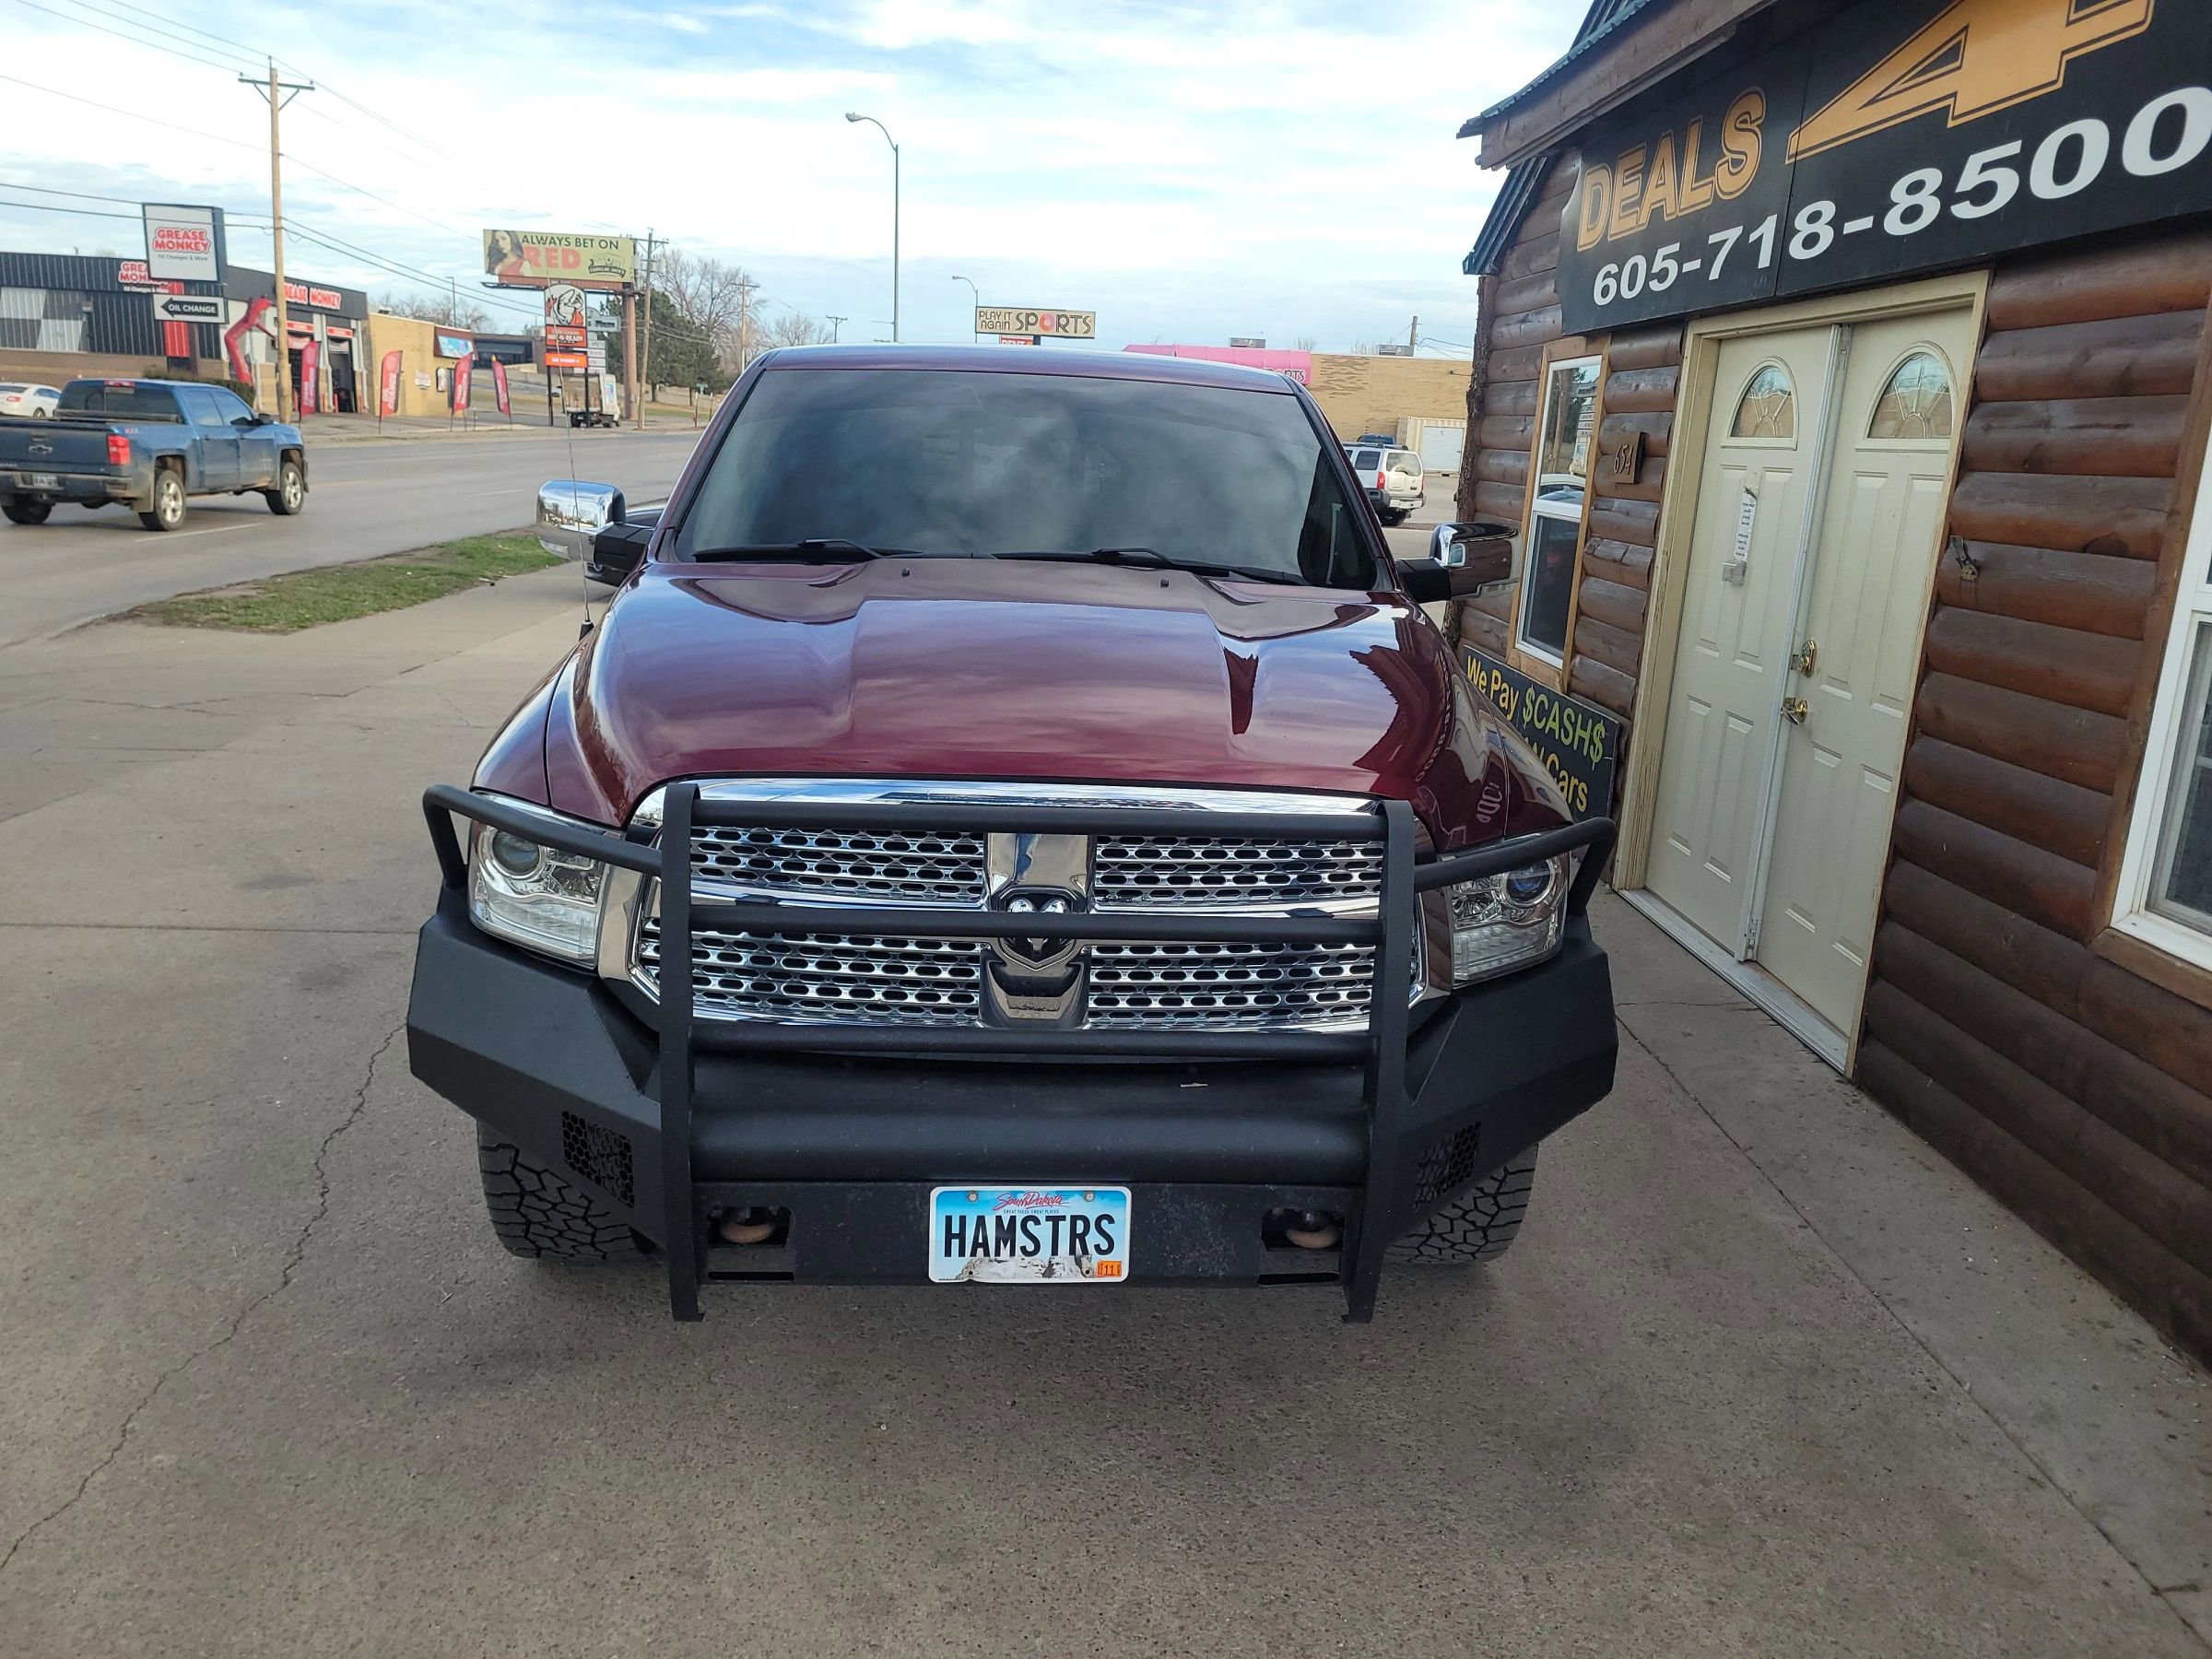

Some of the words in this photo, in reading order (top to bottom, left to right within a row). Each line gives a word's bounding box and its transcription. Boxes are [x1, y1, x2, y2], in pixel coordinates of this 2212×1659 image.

[1577, 86, 1767, 253] DEALS
[1785, 0, 2155, 165] 4
[1593, 87, 2212, 306] 605-718-8500
[157, 229, 206, 241] GREASE
[522, 234, 571, 247] ALWAYS
[574, 237, 594, 248] BET
[598, 239, 619, 250] ON
[154, 240, 209, 252] MONKEY
[524, 246, 582, 269] RED
[122, 263, 147, 273] GRE
[169, 303, 181, 312] OIL
[182, 303, 216, 313] CHANGE
[979, 310, 1001, 321] PLAY
[1004, 312, 1013, 321] IT
[980, 320, 1010, 331] AGAIN
[1015, 312, 1091, 335] SPORTS
[1614, 443, 1634, 476] 654
[1467, 654, 1488, 694] We
[1489, 669, 1520, 722] Pay
[1523, 684, 1606, 771] $CASH$
[1547, 752, 1589, 813] Cars
[993, 1192, 1030, 1210] South
[1029, 1191, 1066, 1207] Dakota
[944, 1213, 1116, 1258] HAMSTRS
[1104, 1265, 1113, 1276] 11
